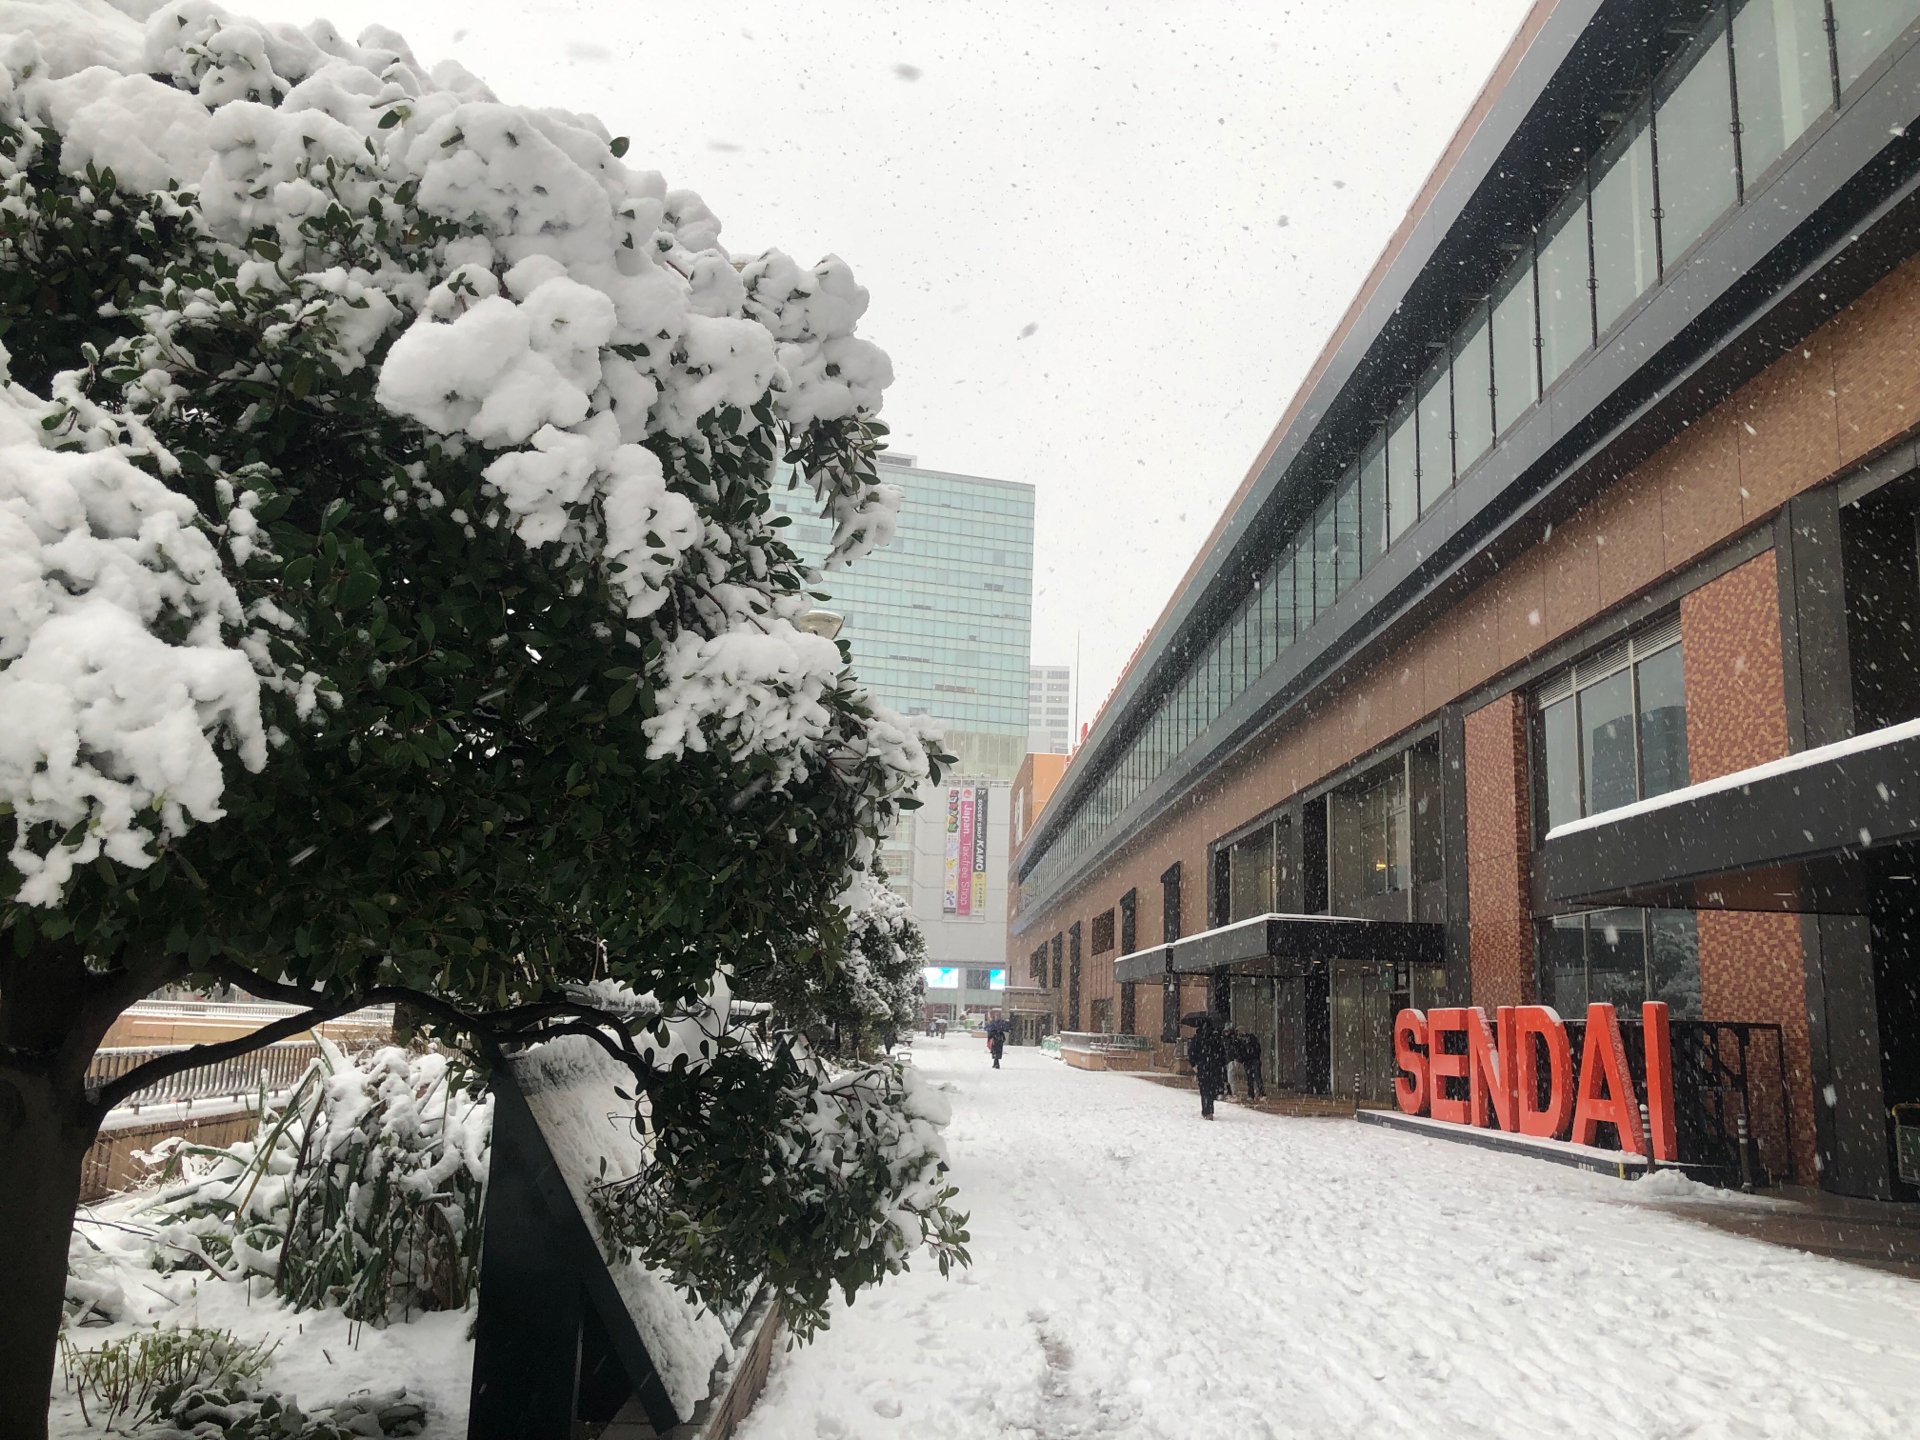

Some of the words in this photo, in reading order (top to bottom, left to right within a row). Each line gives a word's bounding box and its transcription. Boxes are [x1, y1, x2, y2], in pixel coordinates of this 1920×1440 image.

[975, 840, 984, 871] KAMO
[960, 881, 970, 906] Shop
[1394, 1001, 1678, 1162] SENDAI
